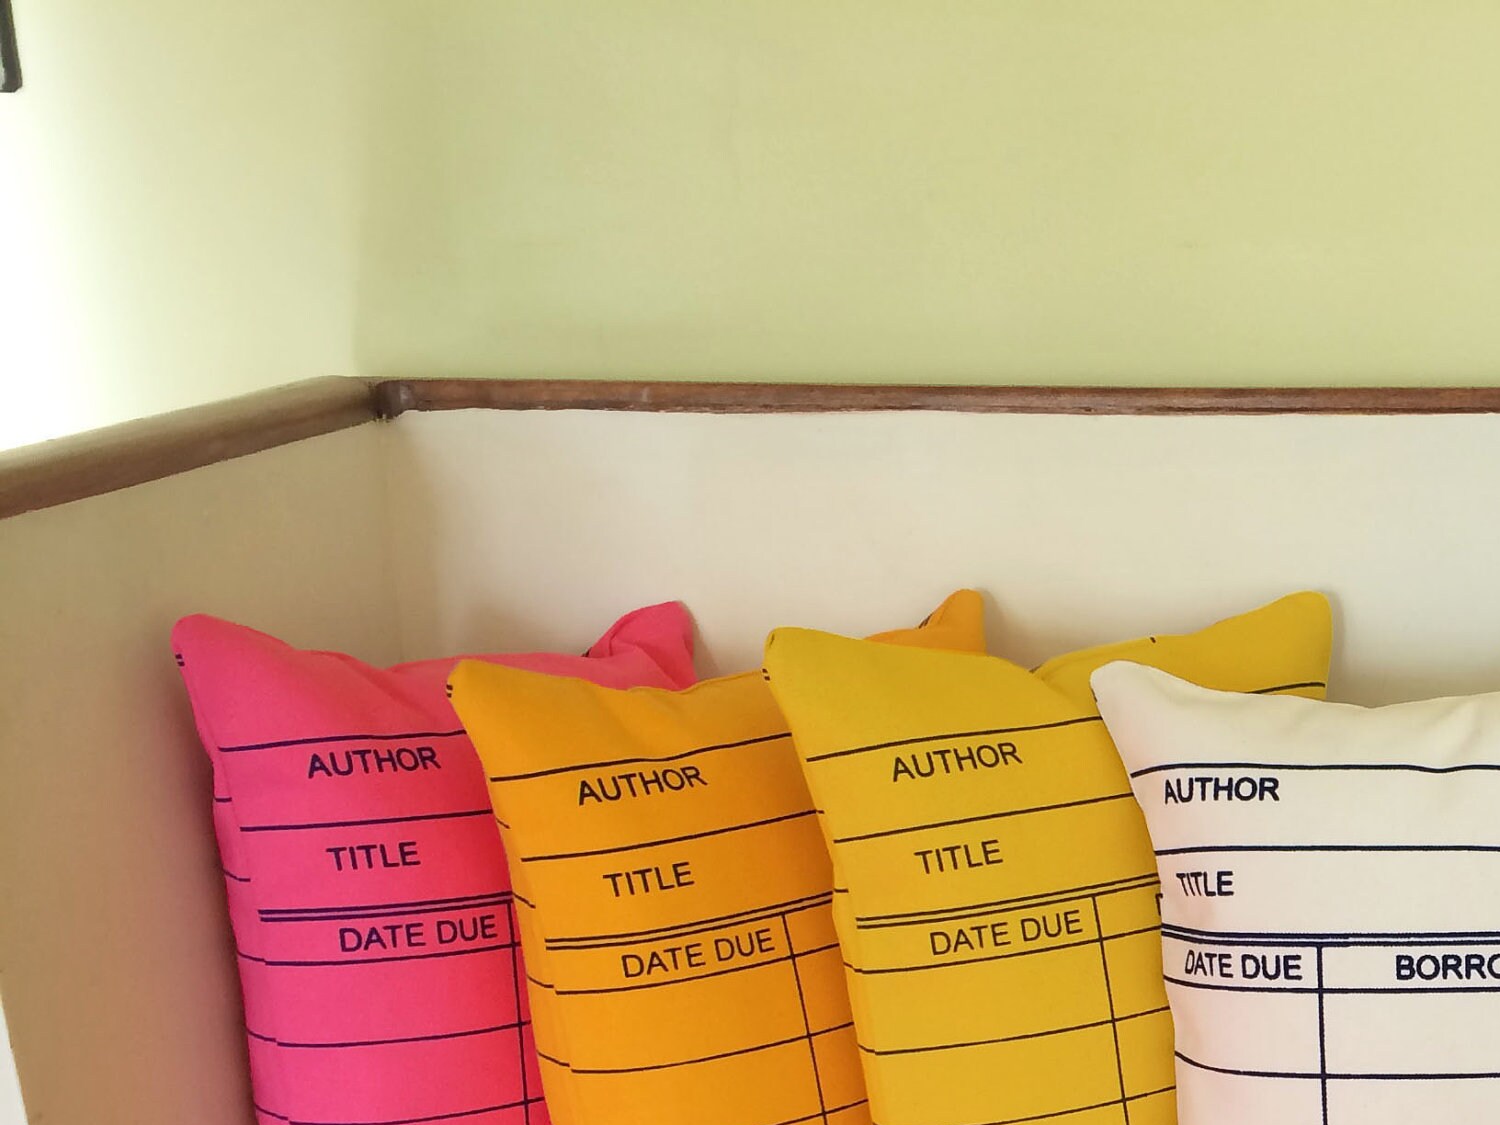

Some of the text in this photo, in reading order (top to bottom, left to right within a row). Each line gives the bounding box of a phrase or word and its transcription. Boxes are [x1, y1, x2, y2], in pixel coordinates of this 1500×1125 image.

[307, 746, 442, 779] AUTHOR
[892, 742, 1023, 782] AUTHOR
[578, 765, 708, 806] AUTHOR
[1164, 776, 1279, 804] AUTHOR
[326, 841, 421, 871] TITLE
[914, 840, 1003, 874] TITLE
[603, 862, 695, 897] TITLE
[1176, 870, 1234, 897] TITLE
[339, 914, 497, 953] DATE DUE
[930, 910, 1083, 956] DATE DUE
[621, 928, 775, 979] DATE DUE
[1184, 950, 1302, 981] DATE DUE
